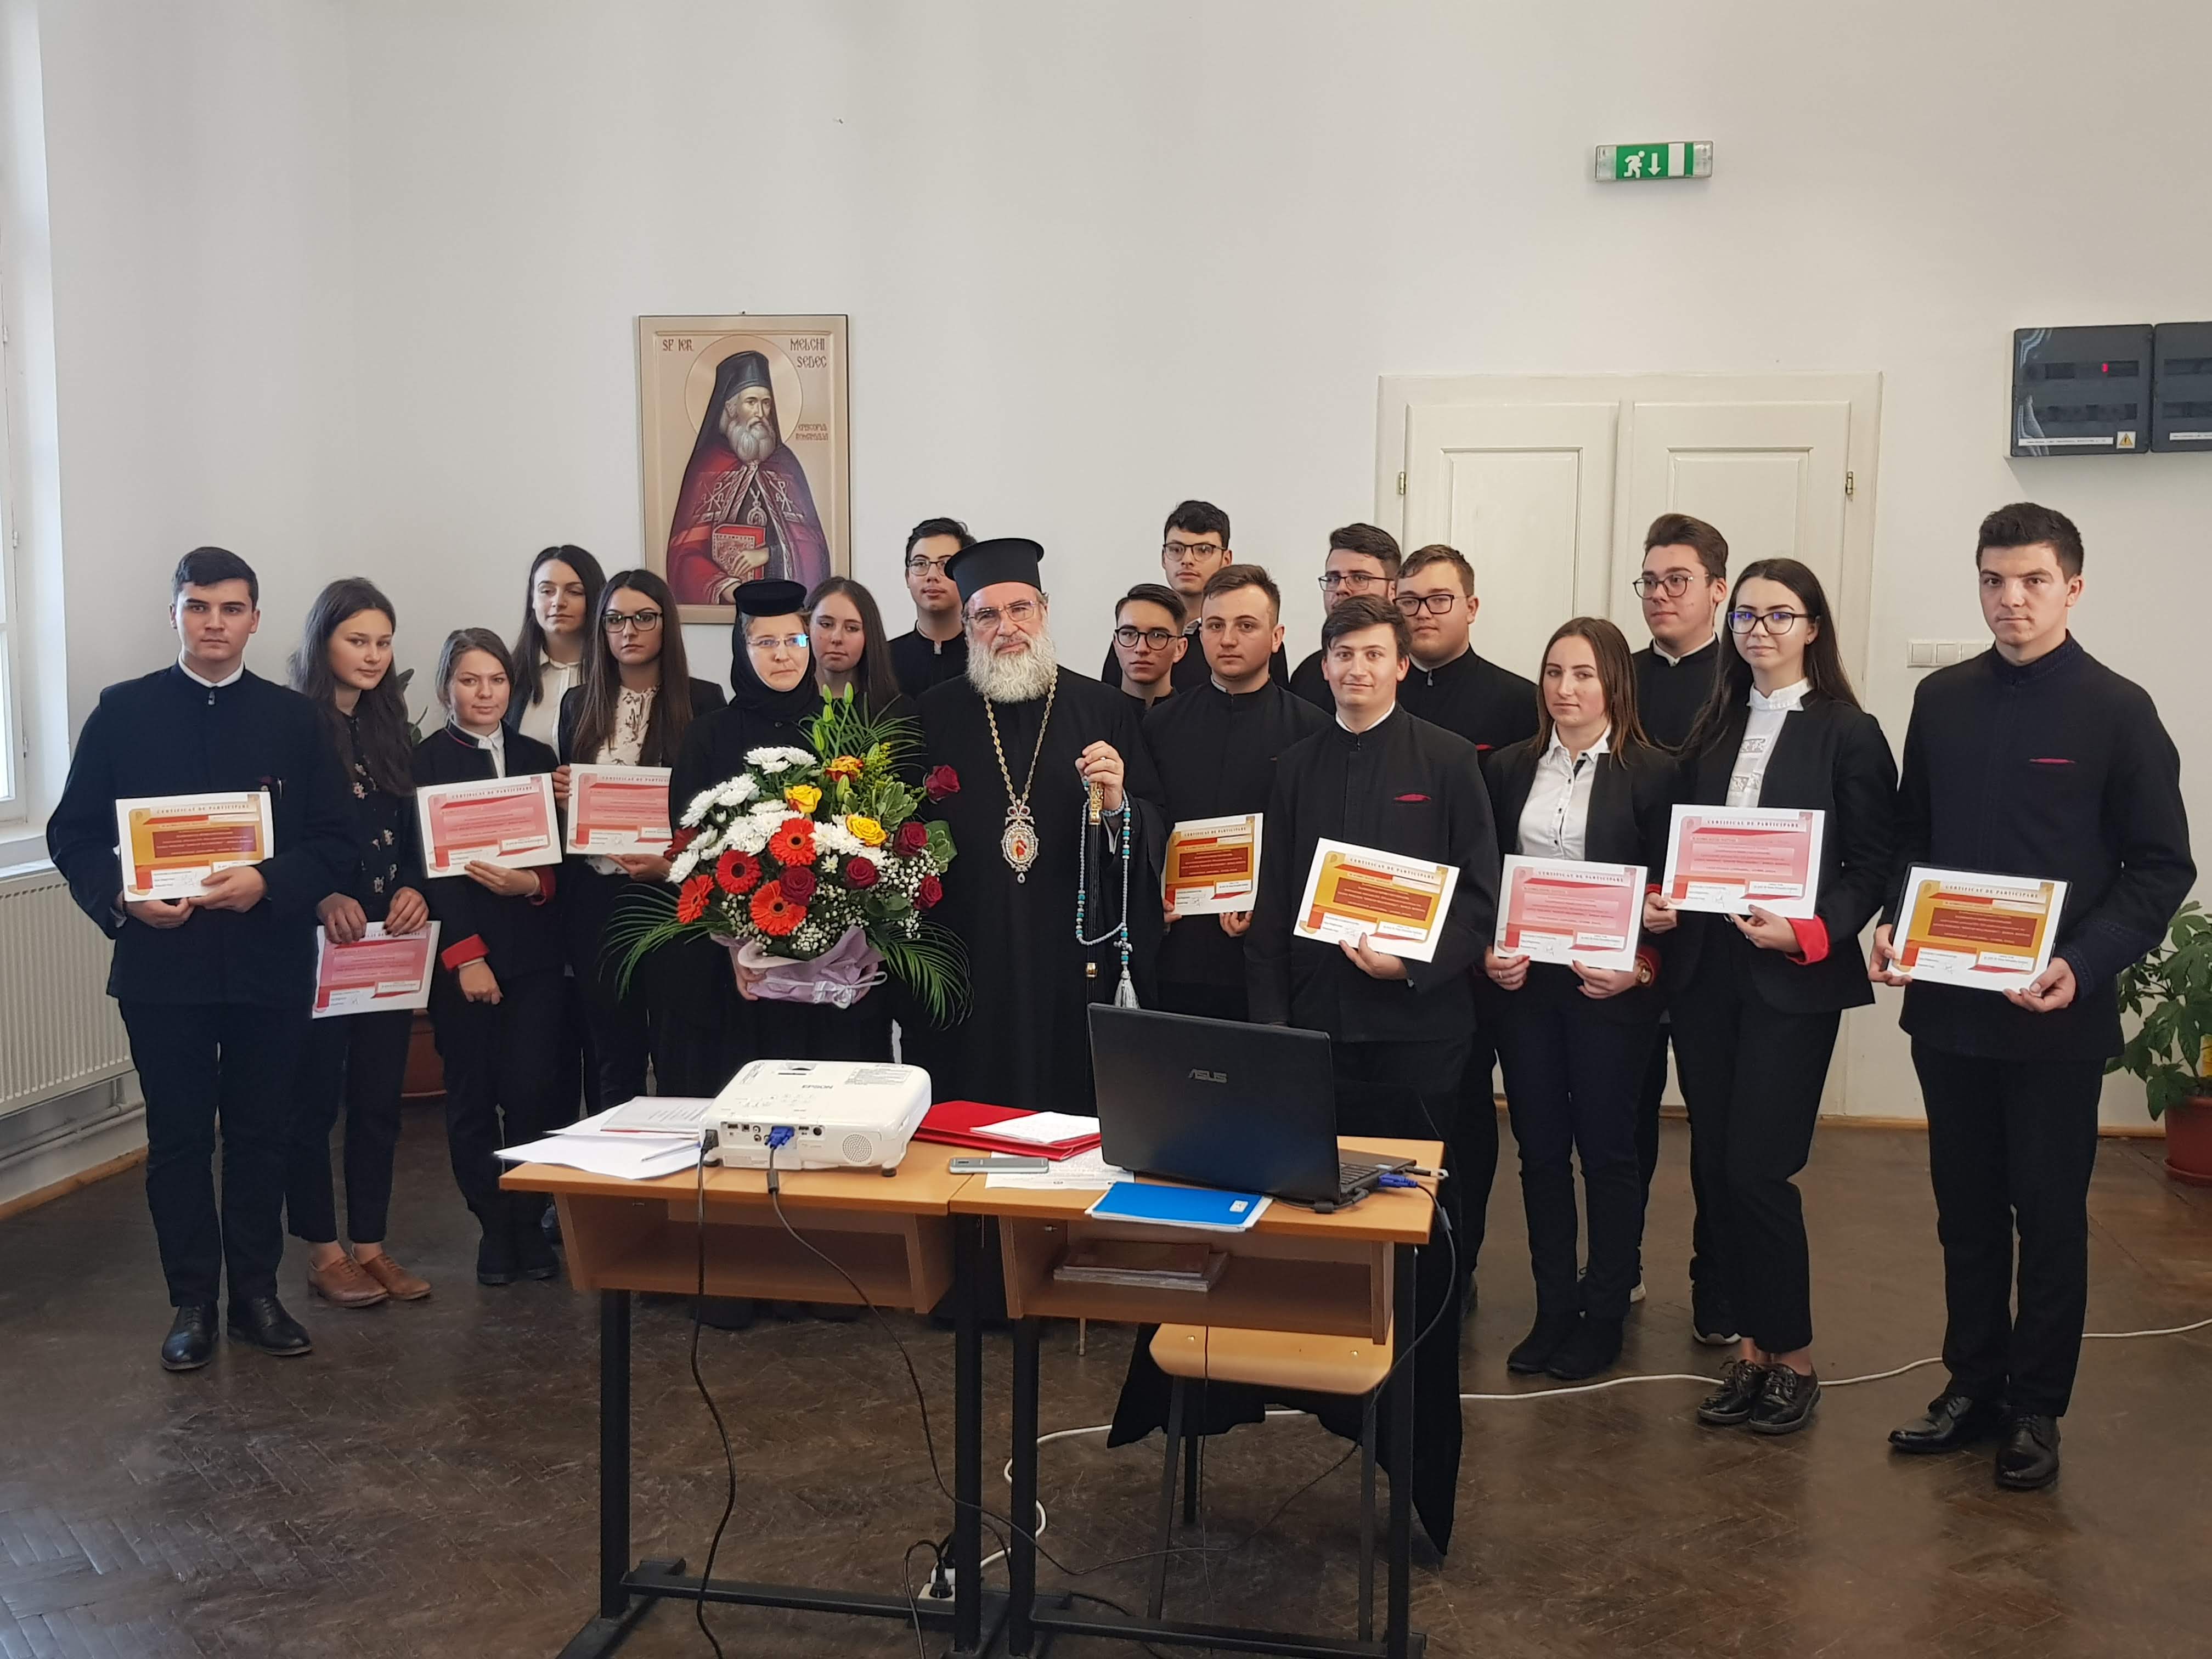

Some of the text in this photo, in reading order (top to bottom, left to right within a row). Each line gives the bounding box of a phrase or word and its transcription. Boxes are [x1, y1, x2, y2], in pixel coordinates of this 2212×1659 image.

[790, 338, 825, 351] MELCHI
[797, 356, 827, 368] SEDEC
[1350, 858, 1385, 869] CERTIFICAT
[1397, 868, 1434, 880] PARTICIPARE
[1996, 890, 2038, 899] PARTICIPARE
[1188, 1068, 1227, 1084] ASUS
